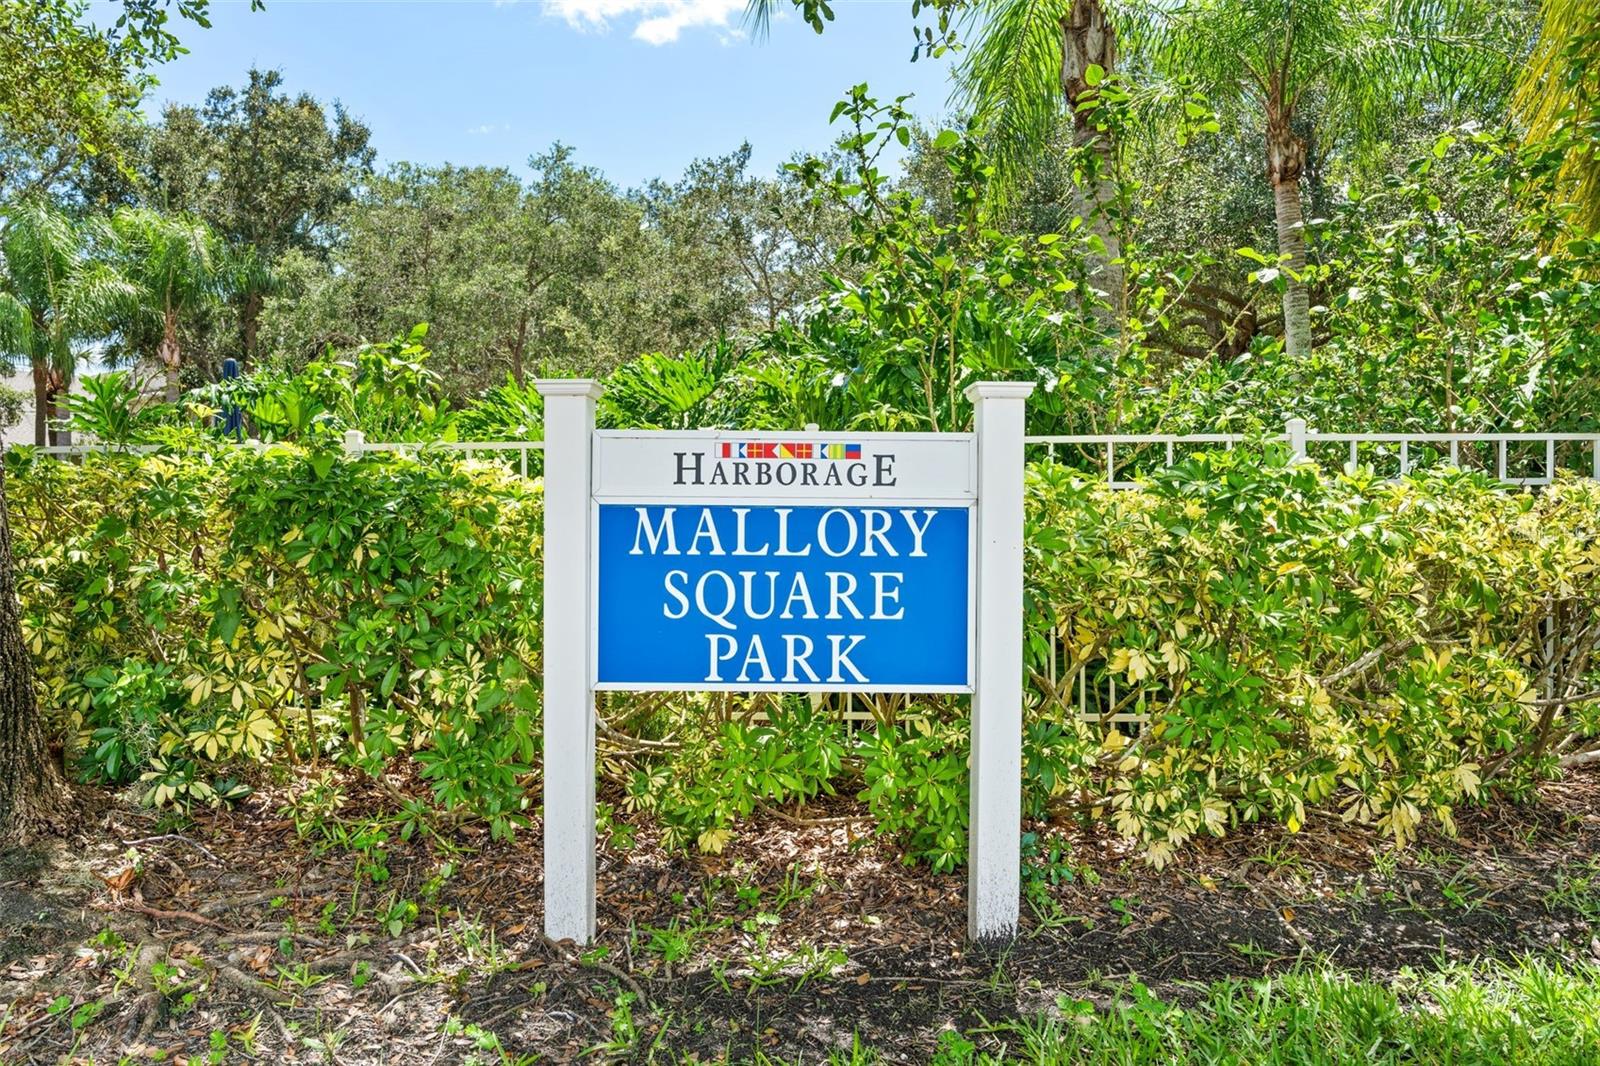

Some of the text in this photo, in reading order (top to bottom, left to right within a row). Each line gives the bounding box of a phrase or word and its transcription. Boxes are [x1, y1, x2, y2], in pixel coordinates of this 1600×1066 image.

[674, 452, 897, 487] HARBORAGE
[629, 508, 938, 557] MALLORY
[663, 570, 905, 630] SQUARE
[704, 634, 870, 683] PARK
